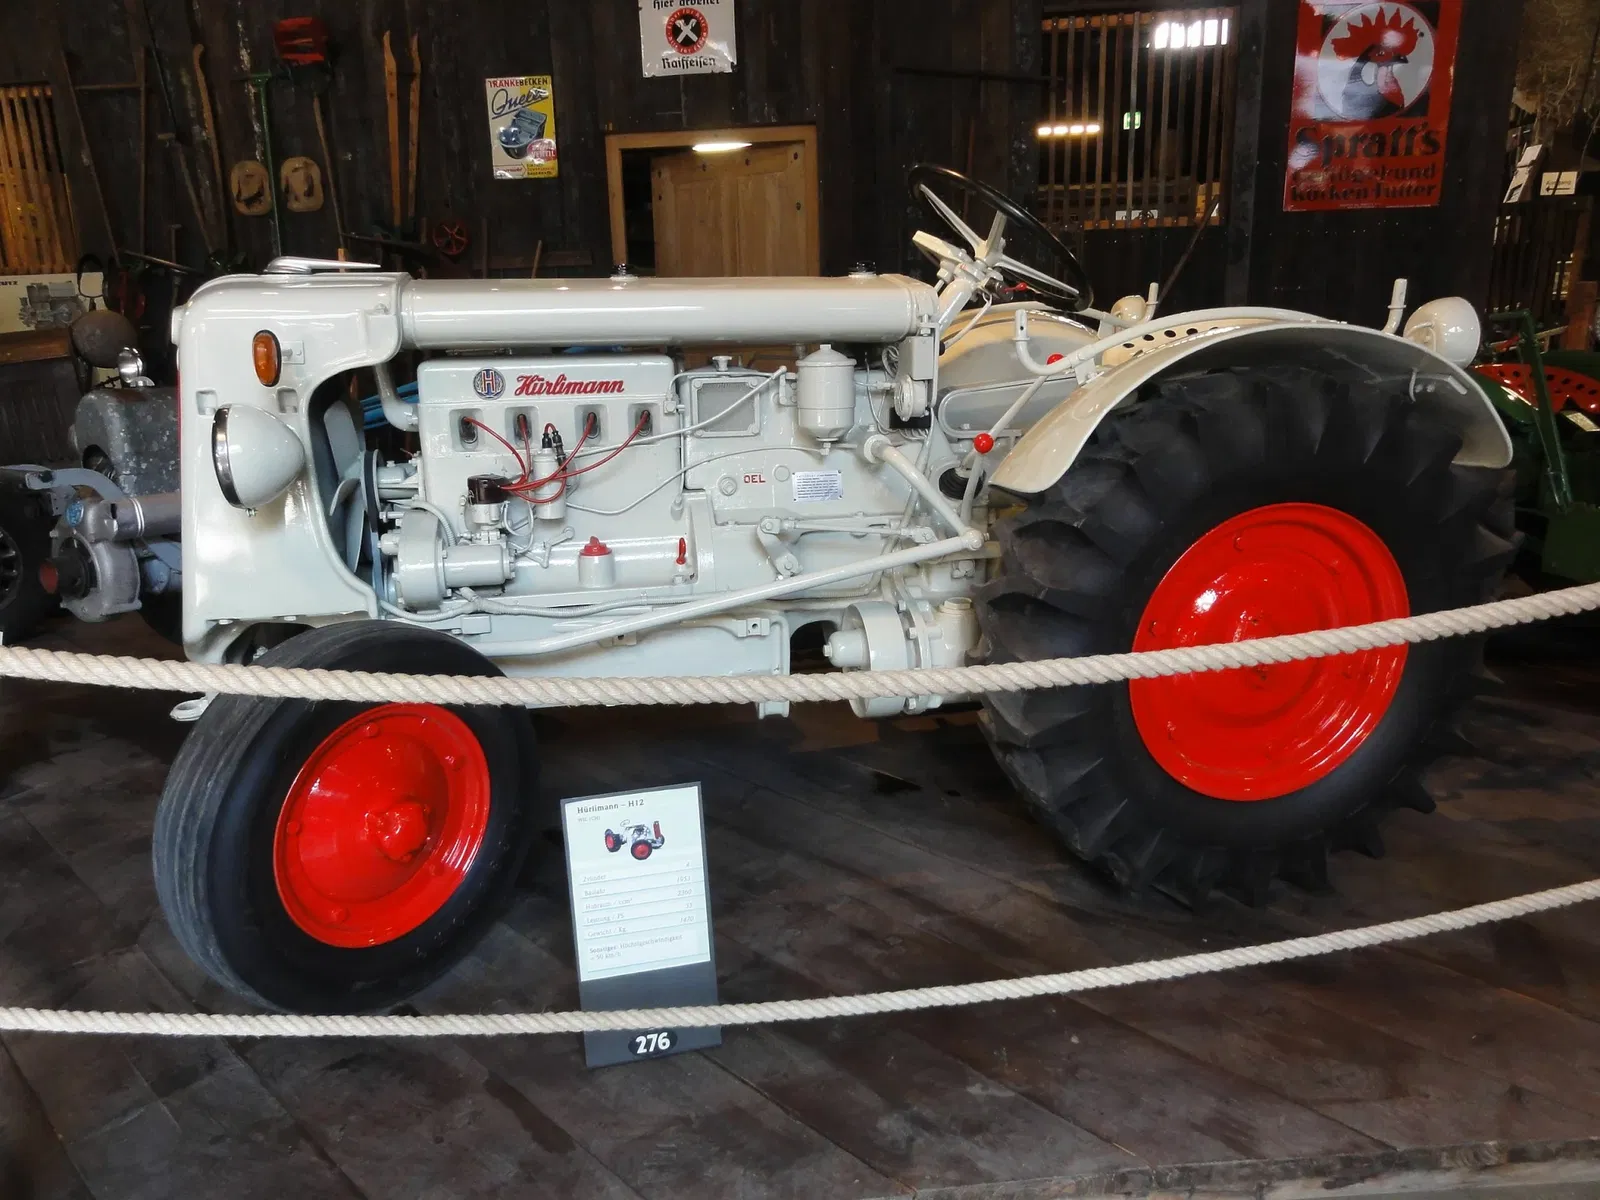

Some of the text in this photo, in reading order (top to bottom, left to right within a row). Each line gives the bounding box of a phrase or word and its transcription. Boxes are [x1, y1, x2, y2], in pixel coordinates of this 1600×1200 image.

[1295, 122, 1441, 167] Spratt's
[515, 373, 625, 396] Hürlimann
[743, 474, 766, 483] OEL
[577, 803, 619, 814] Hürlimann
[635, 1031, 671, 1054] 276
